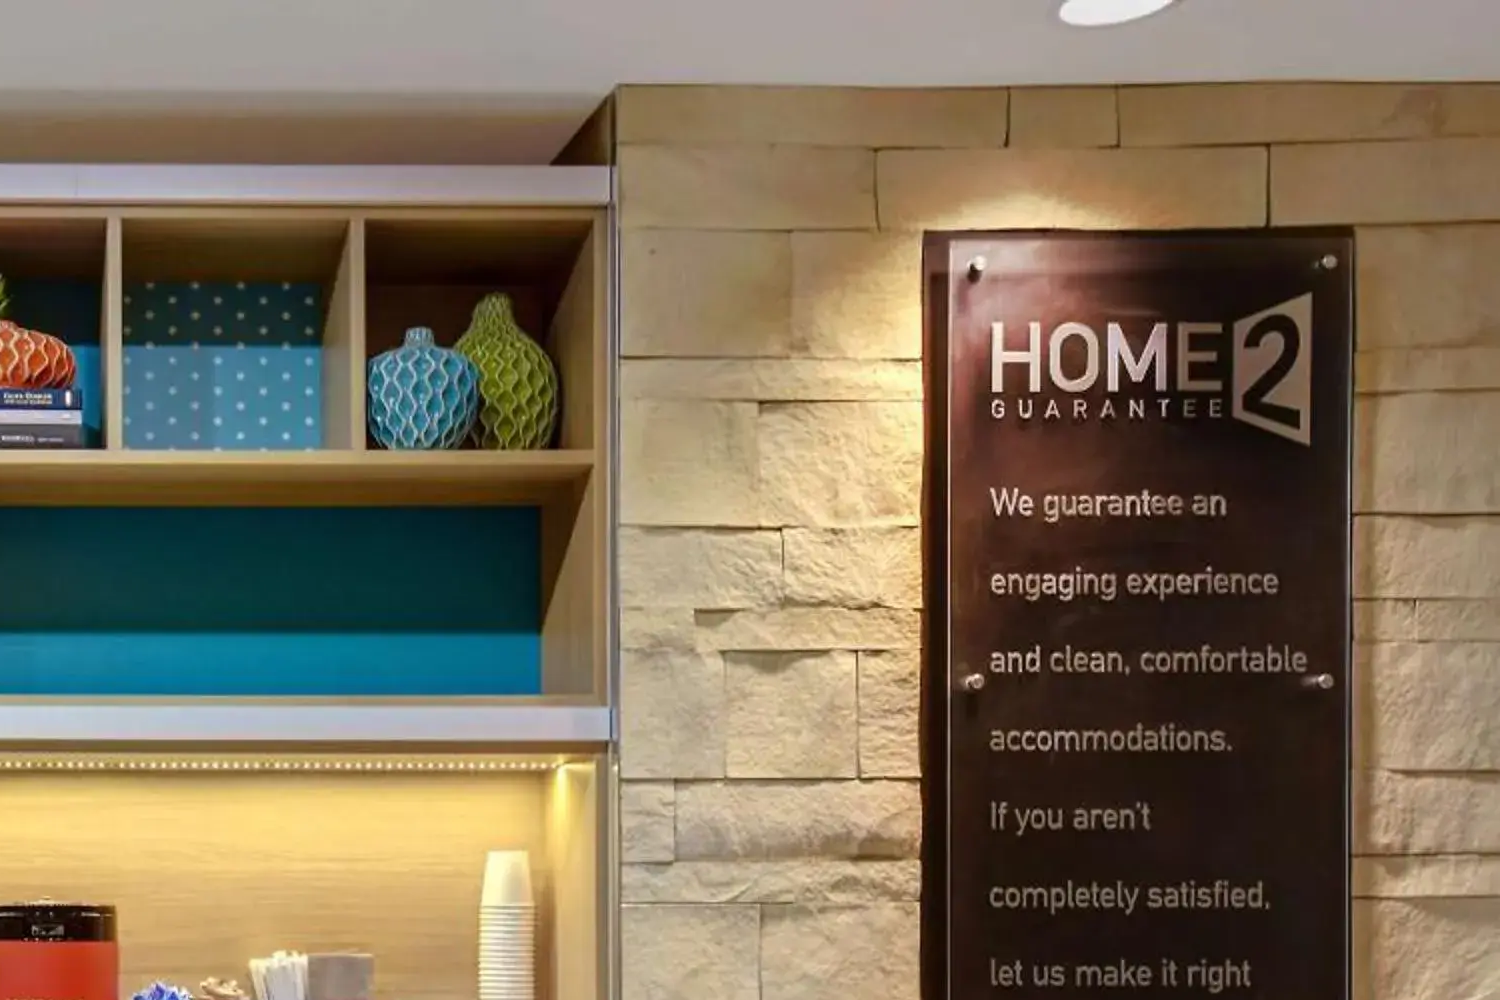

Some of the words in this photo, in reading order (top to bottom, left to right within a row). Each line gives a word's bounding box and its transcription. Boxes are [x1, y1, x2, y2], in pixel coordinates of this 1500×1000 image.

[990, 398, 1223, 419] GUARANTEE
[990, 488, 1034, 517] We
[1043, 489, 1183, 523] guarantee
[1192, 495, 1227, 517] an
[990, 566, 1117, 602] engaging
[1127, 566, 1279, 602] experience
[990, 645, 1041, 674] and
[1050, 645, 1130, 677] clean,
[1140, 644, 1308, 674] comfortable
[989, 722, 1233, 753] accommodations.
[990, 801, 1008, 830] If
[1014, 808, 1063, 837] you
[1073, 801, 1151, 831] aren't
[990, 880, 1139, 915] completely
[990, 958, 1023, 987] let
[1033, 965, 1065, 987] us
[1076, 958, 1152, 987] make
[1161, 958, 1177, 987] it
[1187, 958, 1252, 994] right
